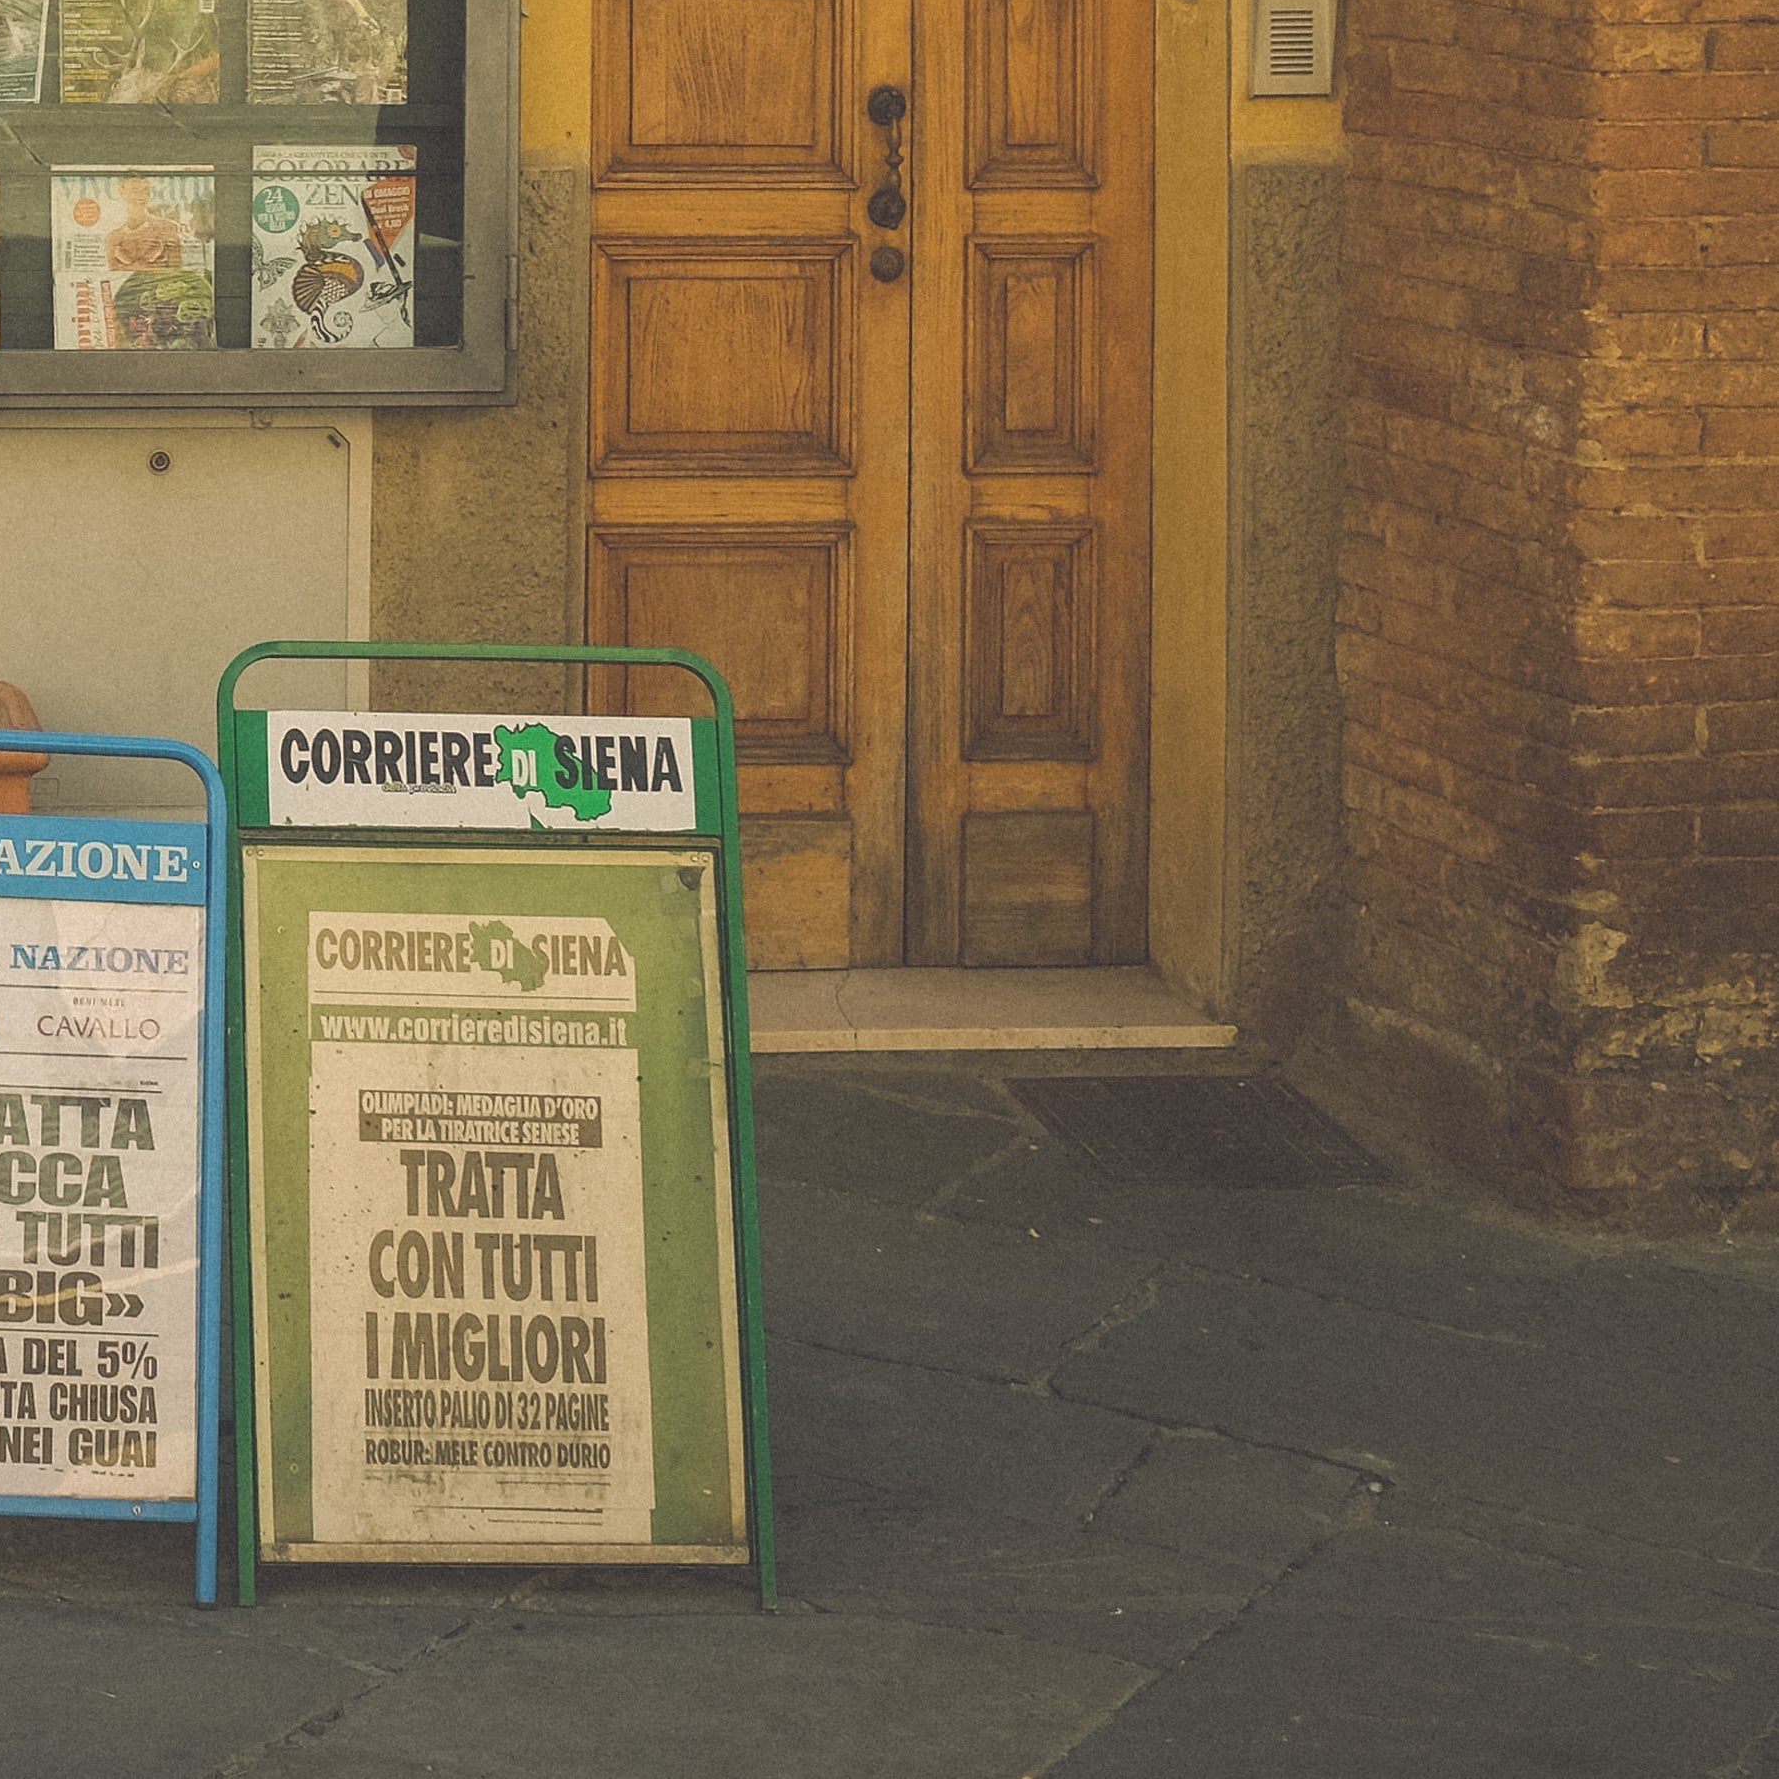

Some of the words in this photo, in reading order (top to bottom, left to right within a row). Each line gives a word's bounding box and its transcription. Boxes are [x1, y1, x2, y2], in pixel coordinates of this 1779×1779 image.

[264, 190, 283, 203] 24
[305, 184, 360, 206] ZEN
[280, 727, 495, 788] CORRIERE
[553, 734, 684, 794] SIENA
[10, 944, 190, 976] NAZIONE
[316, 927, 472, 973] CORRIERE
[531, 934, 628, 977] SIENA
[37, 1015, 161, 1040] CAVALLO
[320, 1014, 628, 1047] www.corrieredisiena.it
[456, 1093, 543, 1119] MEDAGLIA
[380, 1119, 414, 1141] PER
[440, 1120, 519, 1143] TIRATRICE
[521, 1123, 580, 1146] SENESE
[400, 1148, 566, 1221] TRATTA
[16, 1210, 160, 1269] TUTTI
[368, 1229, 466, 1300] CON
[474, 1232, 599, 1303] TUTTI
[22, 1337, 83, 1378] DEL
[391, 1312, 607, 1385] MIGLIORI
[48, 1382, 158, 1424] CHIUSA
[364, 1388, 437, 1429] INSERTO
[544, 1393, 609, 1432] PAGINE
[68, 1428, 157, 1469] GUAI
[434, 1439, 478, 1467] MELE
[482, 1440, 552, 1469] CONTRO
[556, 1441, 611, 1470] DURIO
